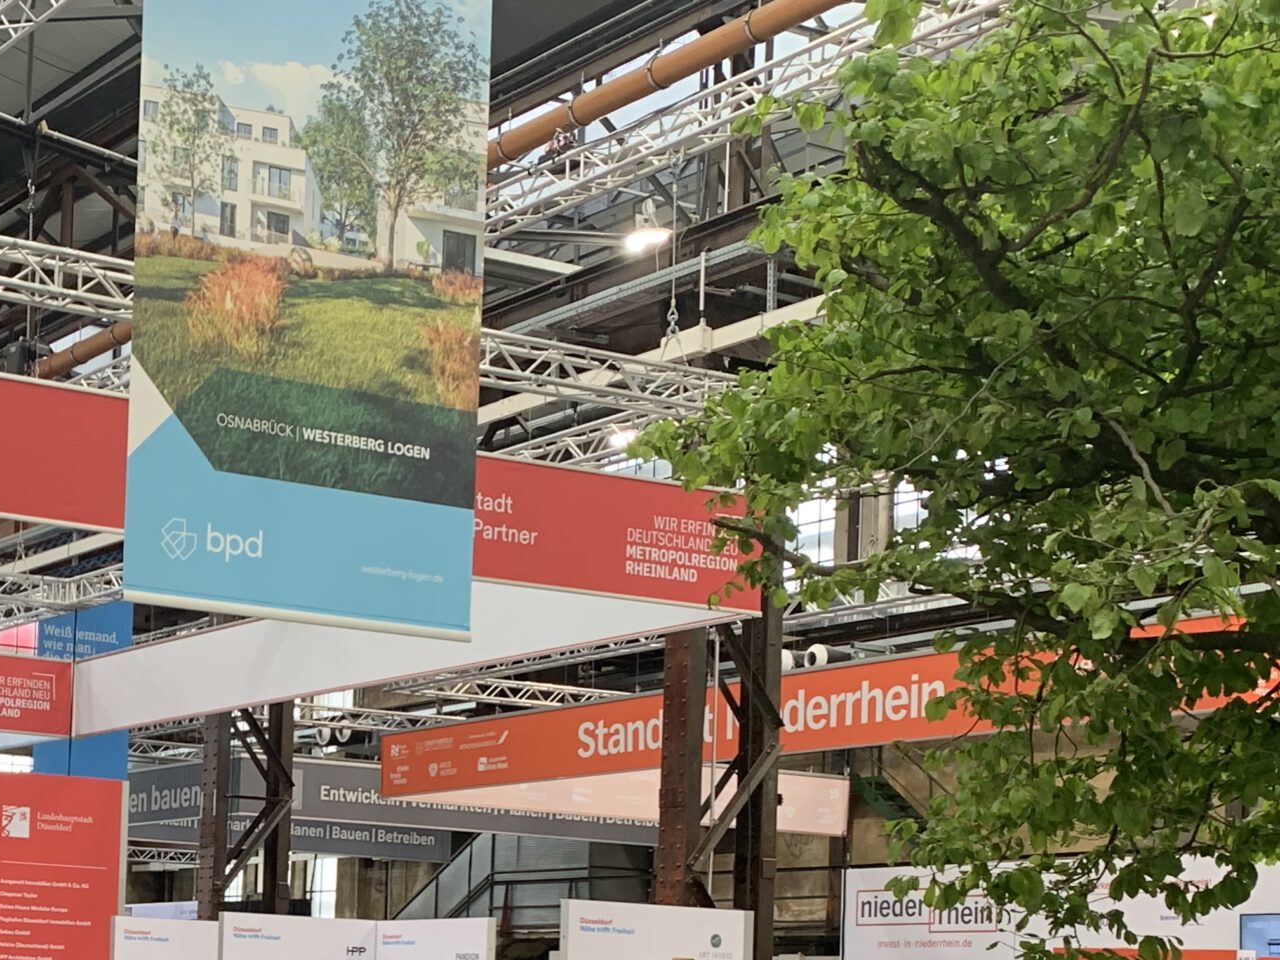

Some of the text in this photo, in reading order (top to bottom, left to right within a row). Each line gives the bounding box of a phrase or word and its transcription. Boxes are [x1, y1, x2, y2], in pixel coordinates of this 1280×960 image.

[216, 412, 431, 461] OSNABRÜCK WESTERBERG LOGEN
[473, 518, 538, 545] Partner
[654, 515, 677, 531] WIR
[206, 522, 263, 563] bpd
[626, 544, 738, 572] METROPOLREGION
[626, 561, 698, 583] RHEINLAND
[7, 676, 50, 690] ERFINDEN
[32, 690, 50, 700] NEU
[577, 704, 713, 759] Standt
[151, 785, 201, 811] bauen
[290, 823, 435, 846] lanen Bauen Betreiben
[347, 946, 367, 956] HPP
